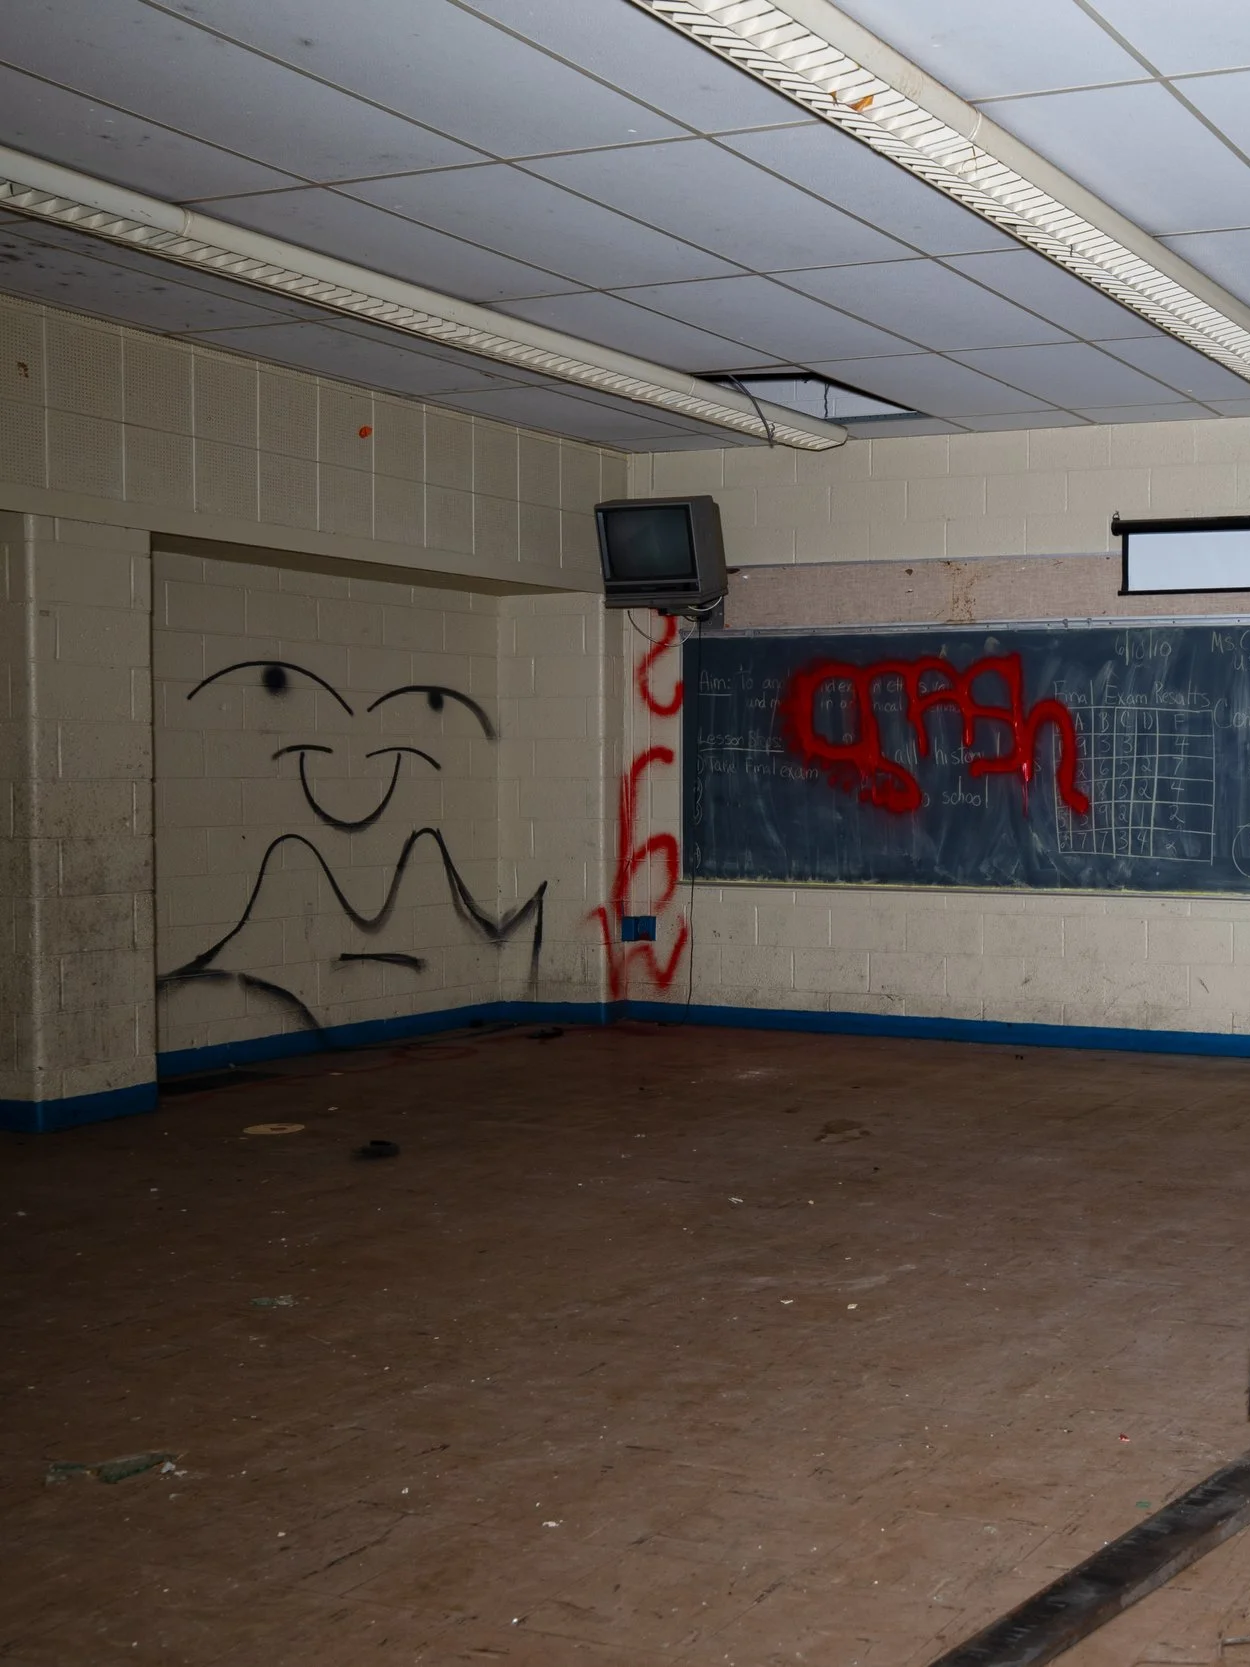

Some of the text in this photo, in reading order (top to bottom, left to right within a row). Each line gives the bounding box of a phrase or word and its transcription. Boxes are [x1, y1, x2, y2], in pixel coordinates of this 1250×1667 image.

[699, 668, 733, 692] Aim:
[1053, 680, 1211, 708] Final Exam Results
[1075, 712, 1085, 731] A
[1099, 711, 1110, 733] B
[1119, 712, 1130, 728] C
[1142, 711, 1154, 729] D
[697, 727, 745, 746] Lesson
[1075, 736, 1087, 756] 9
[1121, 736, 1133, 754] 3
[1174, 737, 1190, 755] 4
[746, 756, 776, 776] Final
[779, 764, 819, 781] exam
[1171, 756, 1184, 776] 7
[939, 774, 990, 810] school
[1077, 832, 1087, 849] 7
[1100, 832, 1109, 854] 7
[1118, 832, 1129, 851] 3
